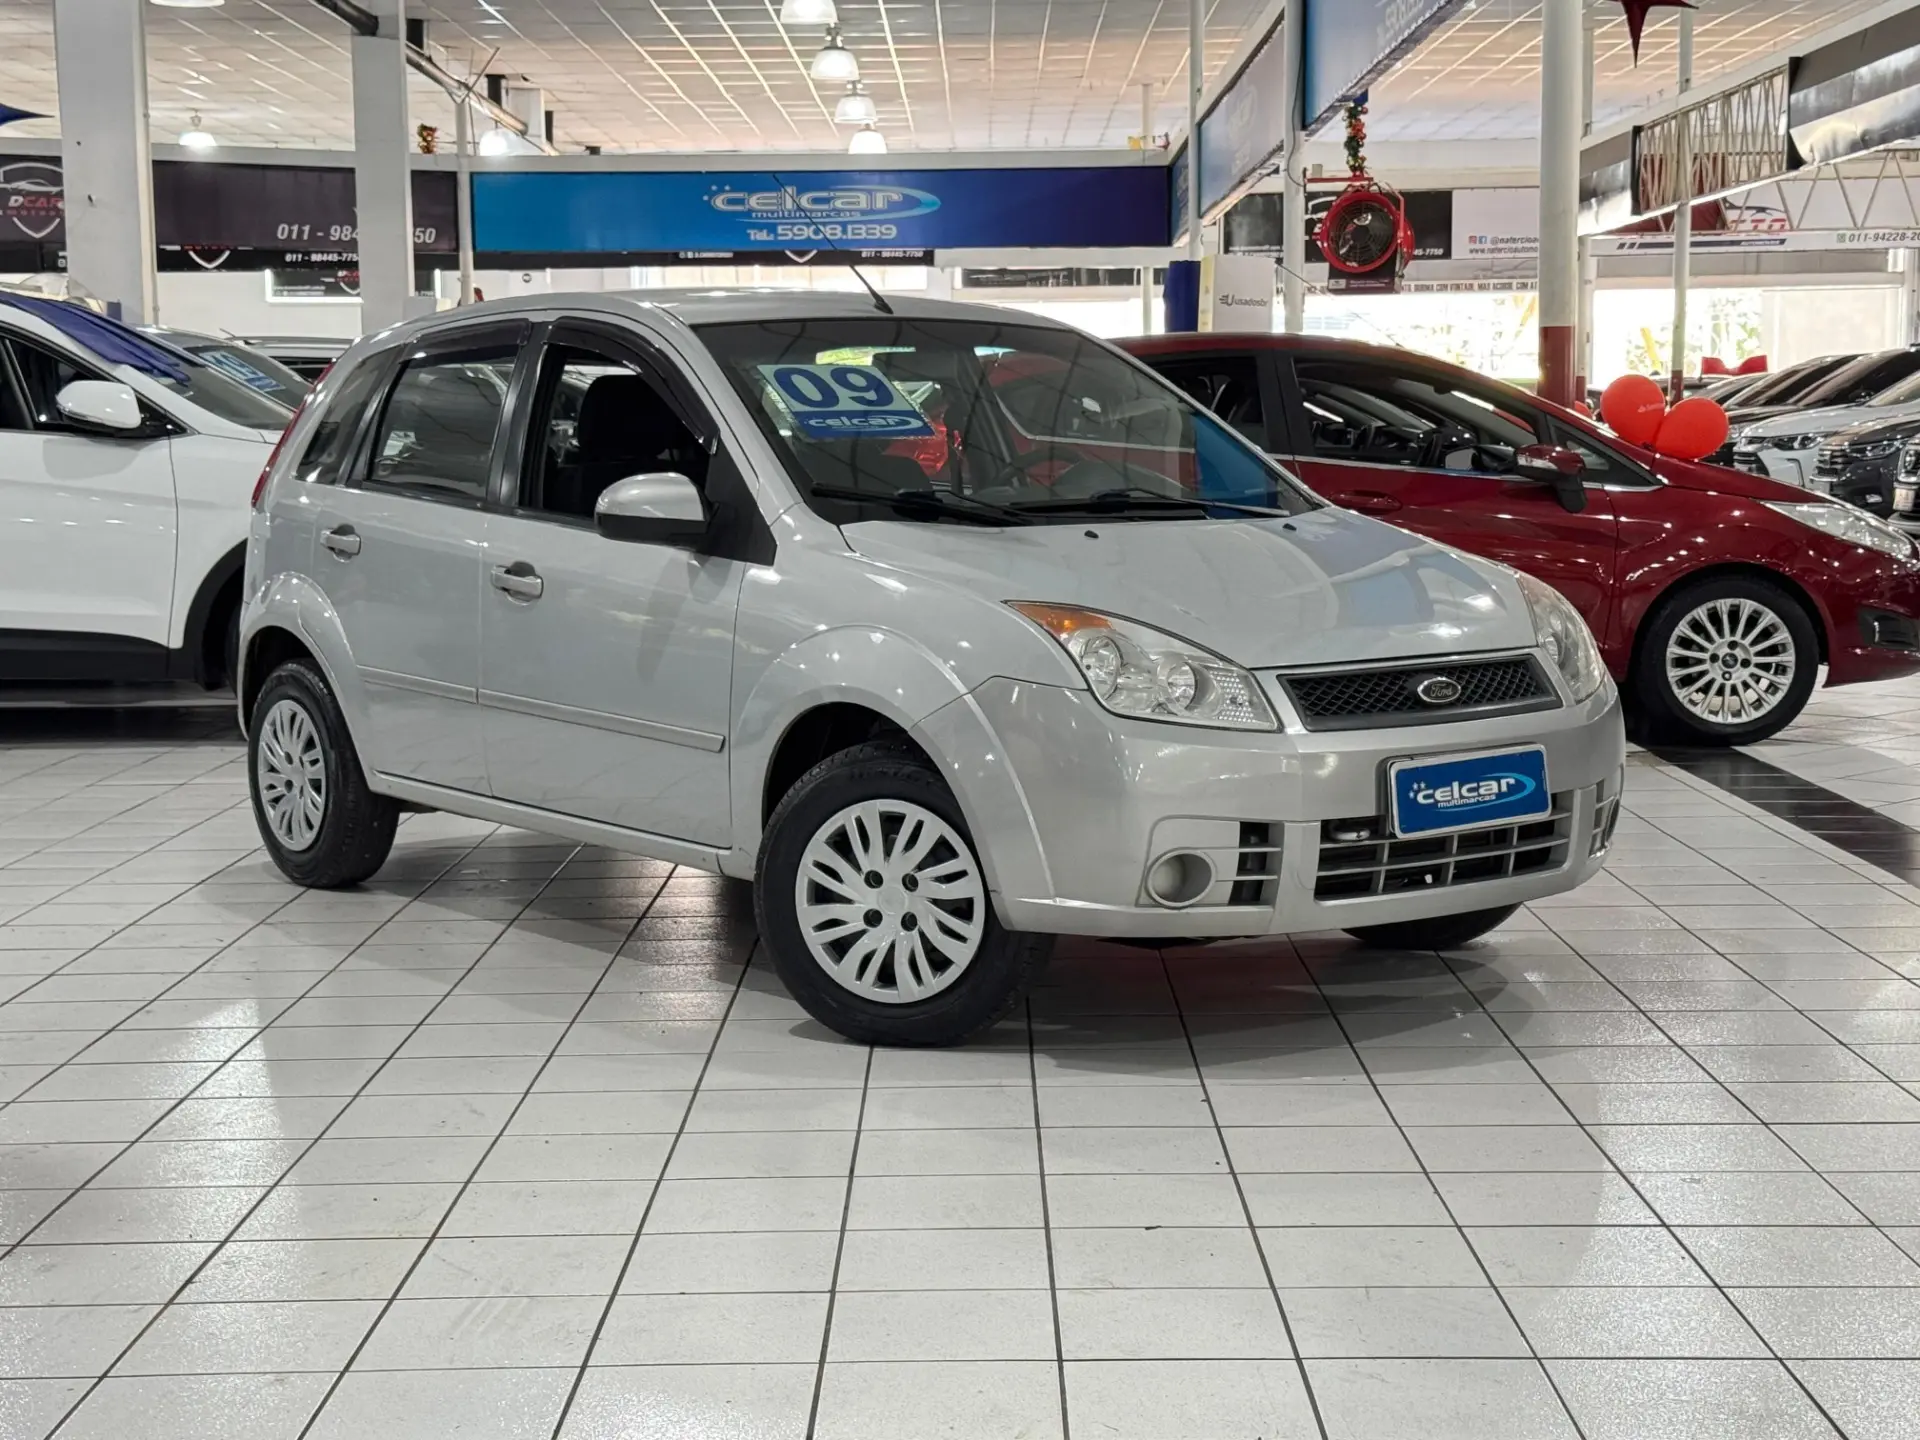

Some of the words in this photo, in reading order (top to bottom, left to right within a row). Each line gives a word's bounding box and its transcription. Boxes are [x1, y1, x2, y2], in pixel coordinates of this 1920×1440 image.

[711, 186, 903, 211] celcar
[751, 211, 861, 219] multimarcas
[277, 223, 311, 240] 011
[310, 253, 359, 262] 98445-775
[773, 367, 894, 408] 09
[808, 416, 898, 427] celcar
[1430, 683, 1453, 697] Ford
[1416, 777, 1516, 804] celcar
[1438, 794, 1496, 809] multimarcas
